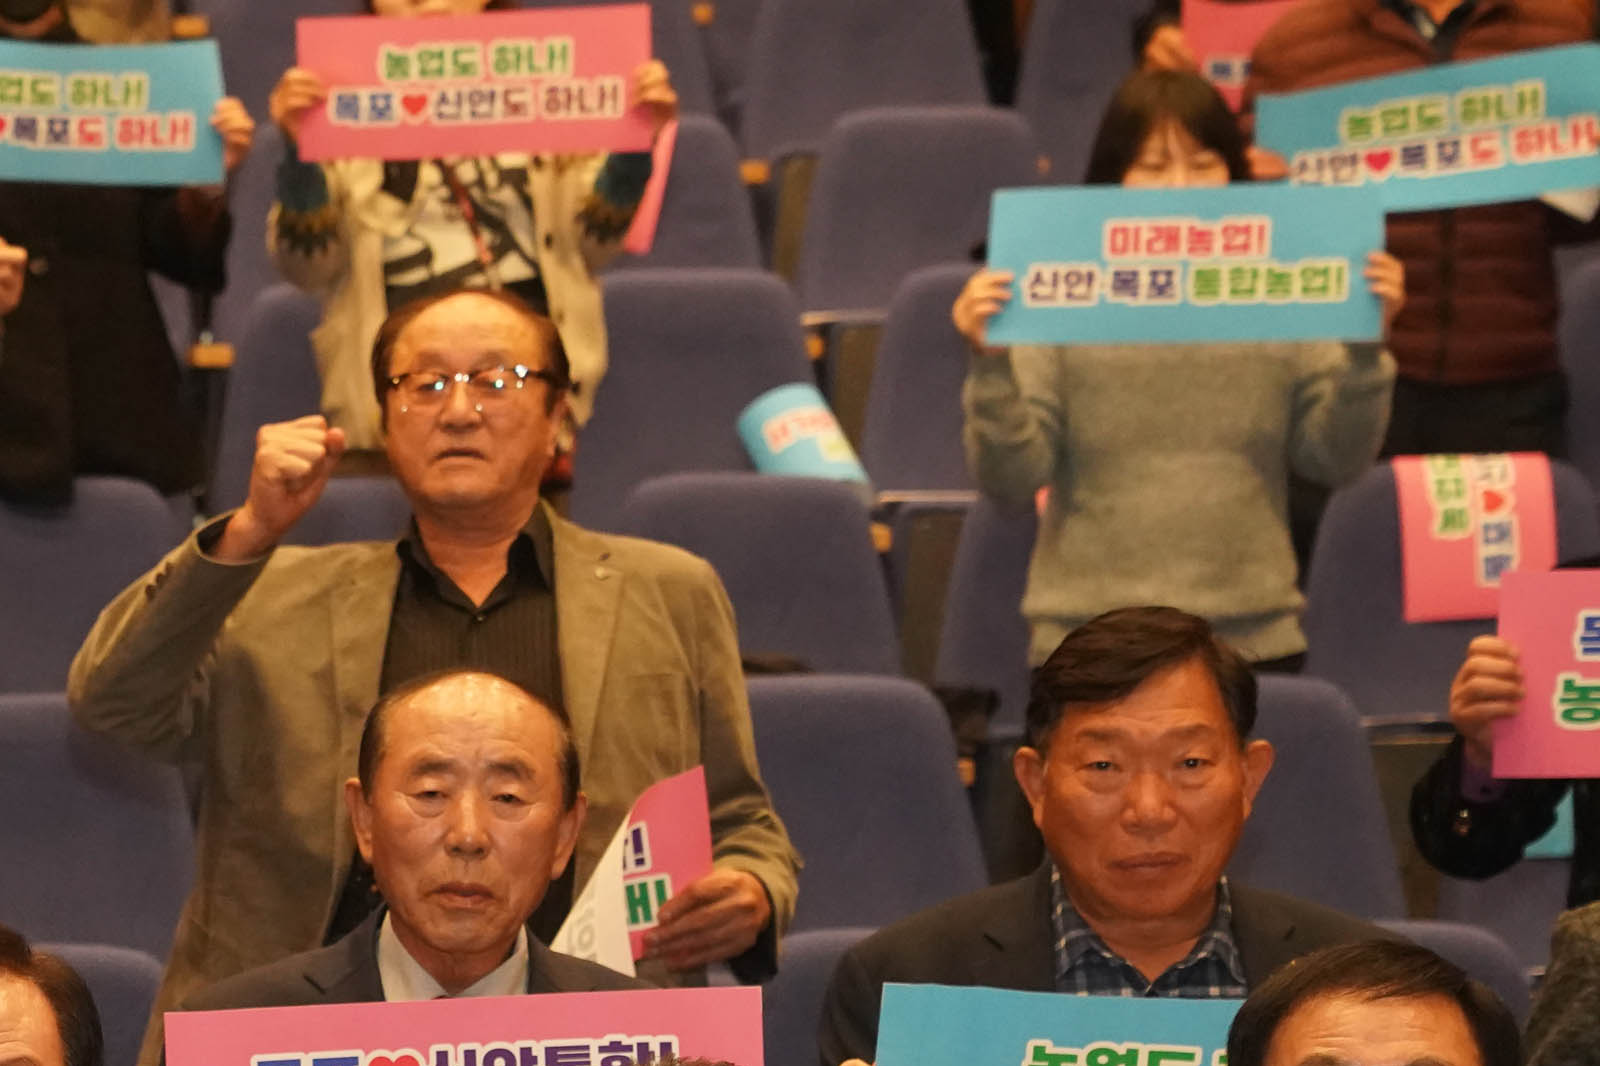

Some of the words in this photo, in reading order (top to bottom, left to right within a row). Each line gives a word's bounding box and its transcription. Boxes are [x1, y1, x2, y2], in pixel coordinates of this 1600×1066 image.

[383, 48, 479, 79] 농업도
[493, 43, 569, 75] 하나!
[69, 75, 145, 108] 하나!
[333, 92, 396, 122] 목포
[432, 87, 532, 119] 신안도
[544, 85, 621, 116] 하나!
[11, 118, 105, 147] 목포도
[116, 116, 193, 148] 하나!
[1108, 223, 1266, 257] 미래농업!
[1191, 263, 1345, 298] 통합농업!
